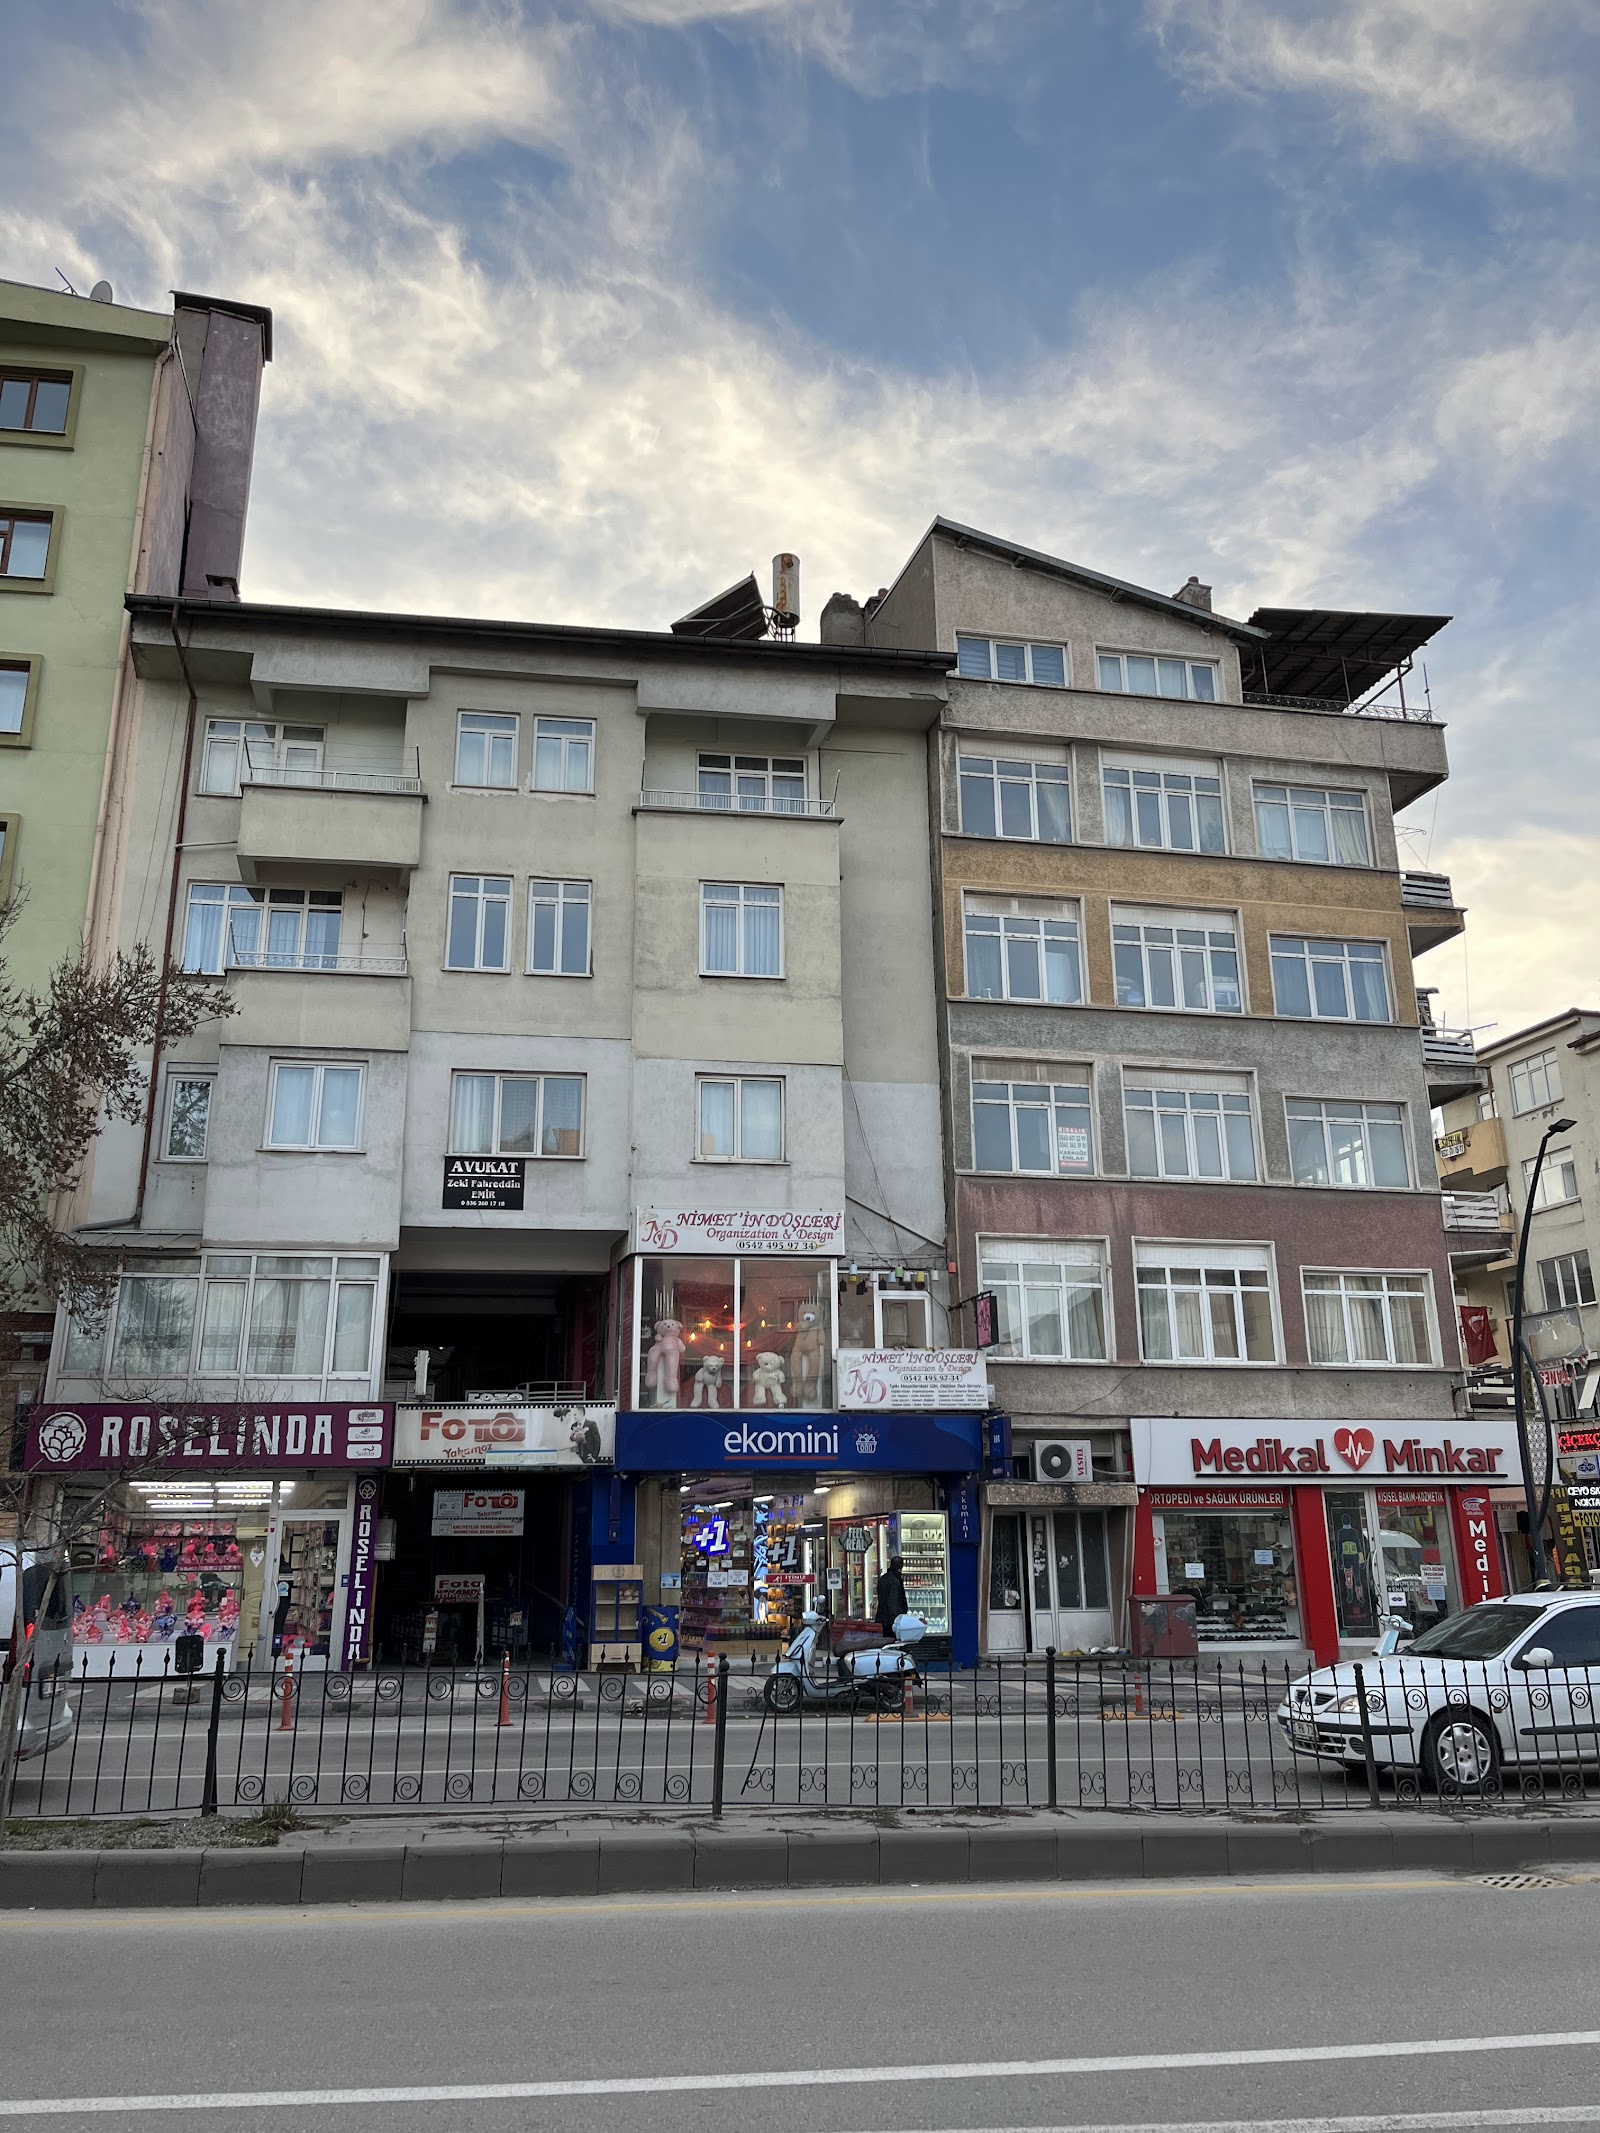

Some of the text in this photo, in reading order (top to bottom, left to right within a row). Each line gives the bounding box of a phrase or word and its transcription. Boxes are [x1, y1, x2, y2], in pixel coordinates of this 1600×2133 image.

[451, 1161, 518, 1173] AVUKAT
[447, 1179, 520, 1188] Zeki Fahreddin
[471, 1189, 495, 1199] EMİR
[766, 1212, 842, 1232] DÜŞLERİ
[706, 1228, 834, 1242] Organization & Design
[925, 1351, 978, 1366] DÜŞLERİ
[889, 1365, 935, 1374] Organization
[947, 1365, 971, 1374] Design
[100, 1414, 333, 1458] ROSELINDA
[724, 1422, 838, 1453] ekomini
[442, 1443, 493, 1459] Yakamoz
[1190, 1437, 1503, 1472] Medikal Minkar
[1076, 1449, 1084, 1476] VESTEL
[1194, 1495, 1204, 1504] ve
[1206, 1490, 1238, 1504] SAĞLIK
[1240, 1490, 1284, 1504] ÜRÜNLERİ
[1568, 1487, 1589, 1496] CEYO
[961, 1489, 969, 1539] ekomini
[1580, 1513, 1600, 1525] FOTO
[696, 1521, 726, 1552] +1
[848, 1527, 863, 1538] FEEL
[768, 1536, 797, 1566] +1
[846, 1539, 866, 1550] REAL
[347, 1504, 371, 1660] ROSELINDA
[436, 1589, 480, 1599] YAKAMO
